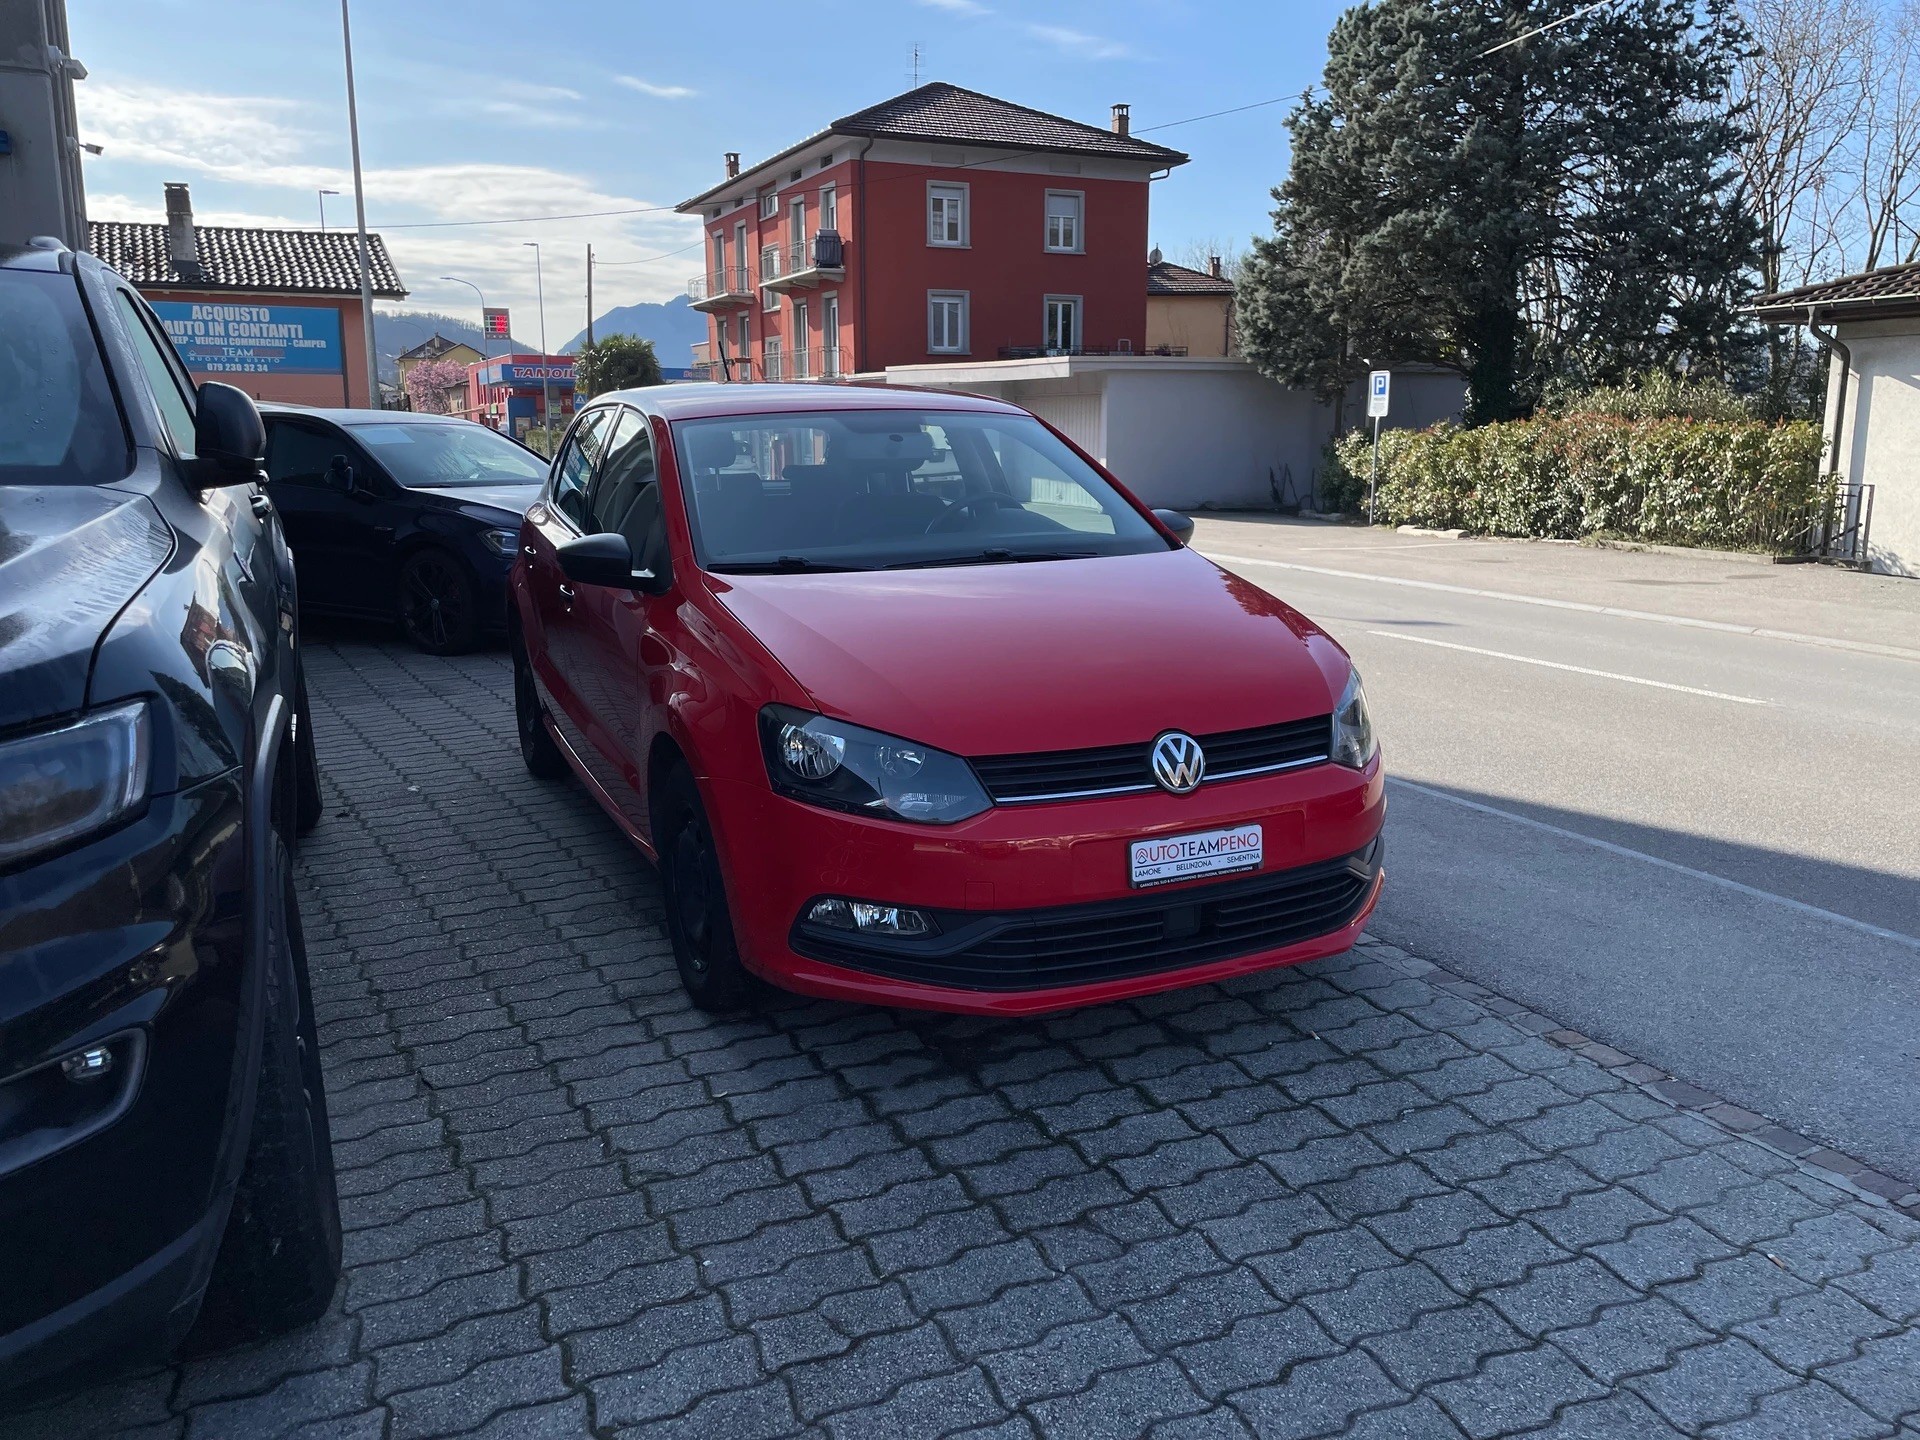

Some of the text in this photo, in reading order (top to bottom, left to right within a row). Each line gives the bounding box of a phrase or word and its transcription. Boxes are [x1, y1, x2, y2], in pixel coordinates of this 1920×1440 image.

[192, 305, 270, 322] ACQUISTO
[164, 320, 302, 338] AUTO IN CONTANTI
[195, 337, 227, 346] VEICOLI
[229, 338, 286, 347] COMMERCIALI
[293, 339, 326, 348] CAMPER
[222, 347, 254, 357] TEAM
[207, 363, 223, 371] 079
[244, 364, 255, 372] 32
[256, 364, 268, 372] 34
[512, 366, 577, 380] TAMOIL
[1376, 377, 1384, 394] P
[1134, 851, 1260, 878] LAMONE BELLINZONA SEMENTINA
